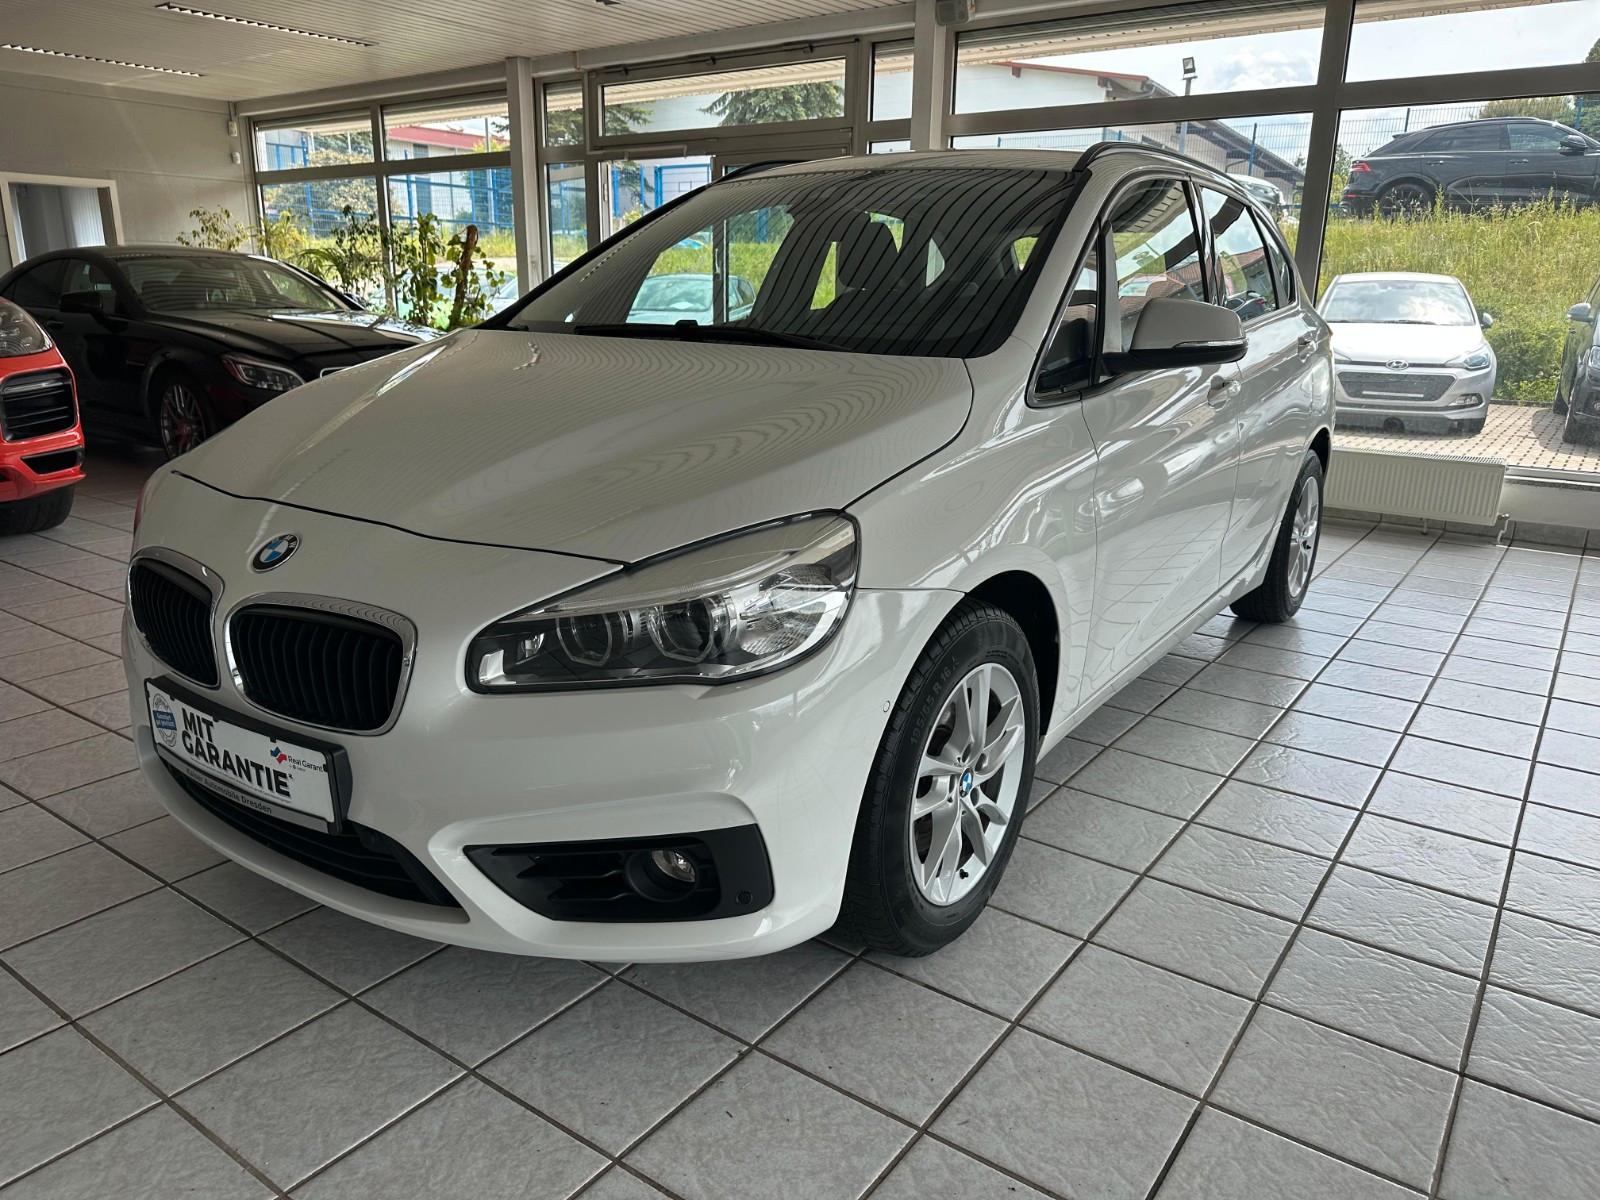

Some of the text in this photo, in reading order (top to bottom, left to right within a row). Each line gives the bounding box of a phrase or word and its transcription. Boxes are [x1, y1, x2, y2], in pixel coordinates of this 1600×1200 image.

[181, 707, 214, 743] MIT
[288, 754, 302, 766] Real
[302, 760, 324, 772] Garant
[241, 796, 272, 815] Dresden
